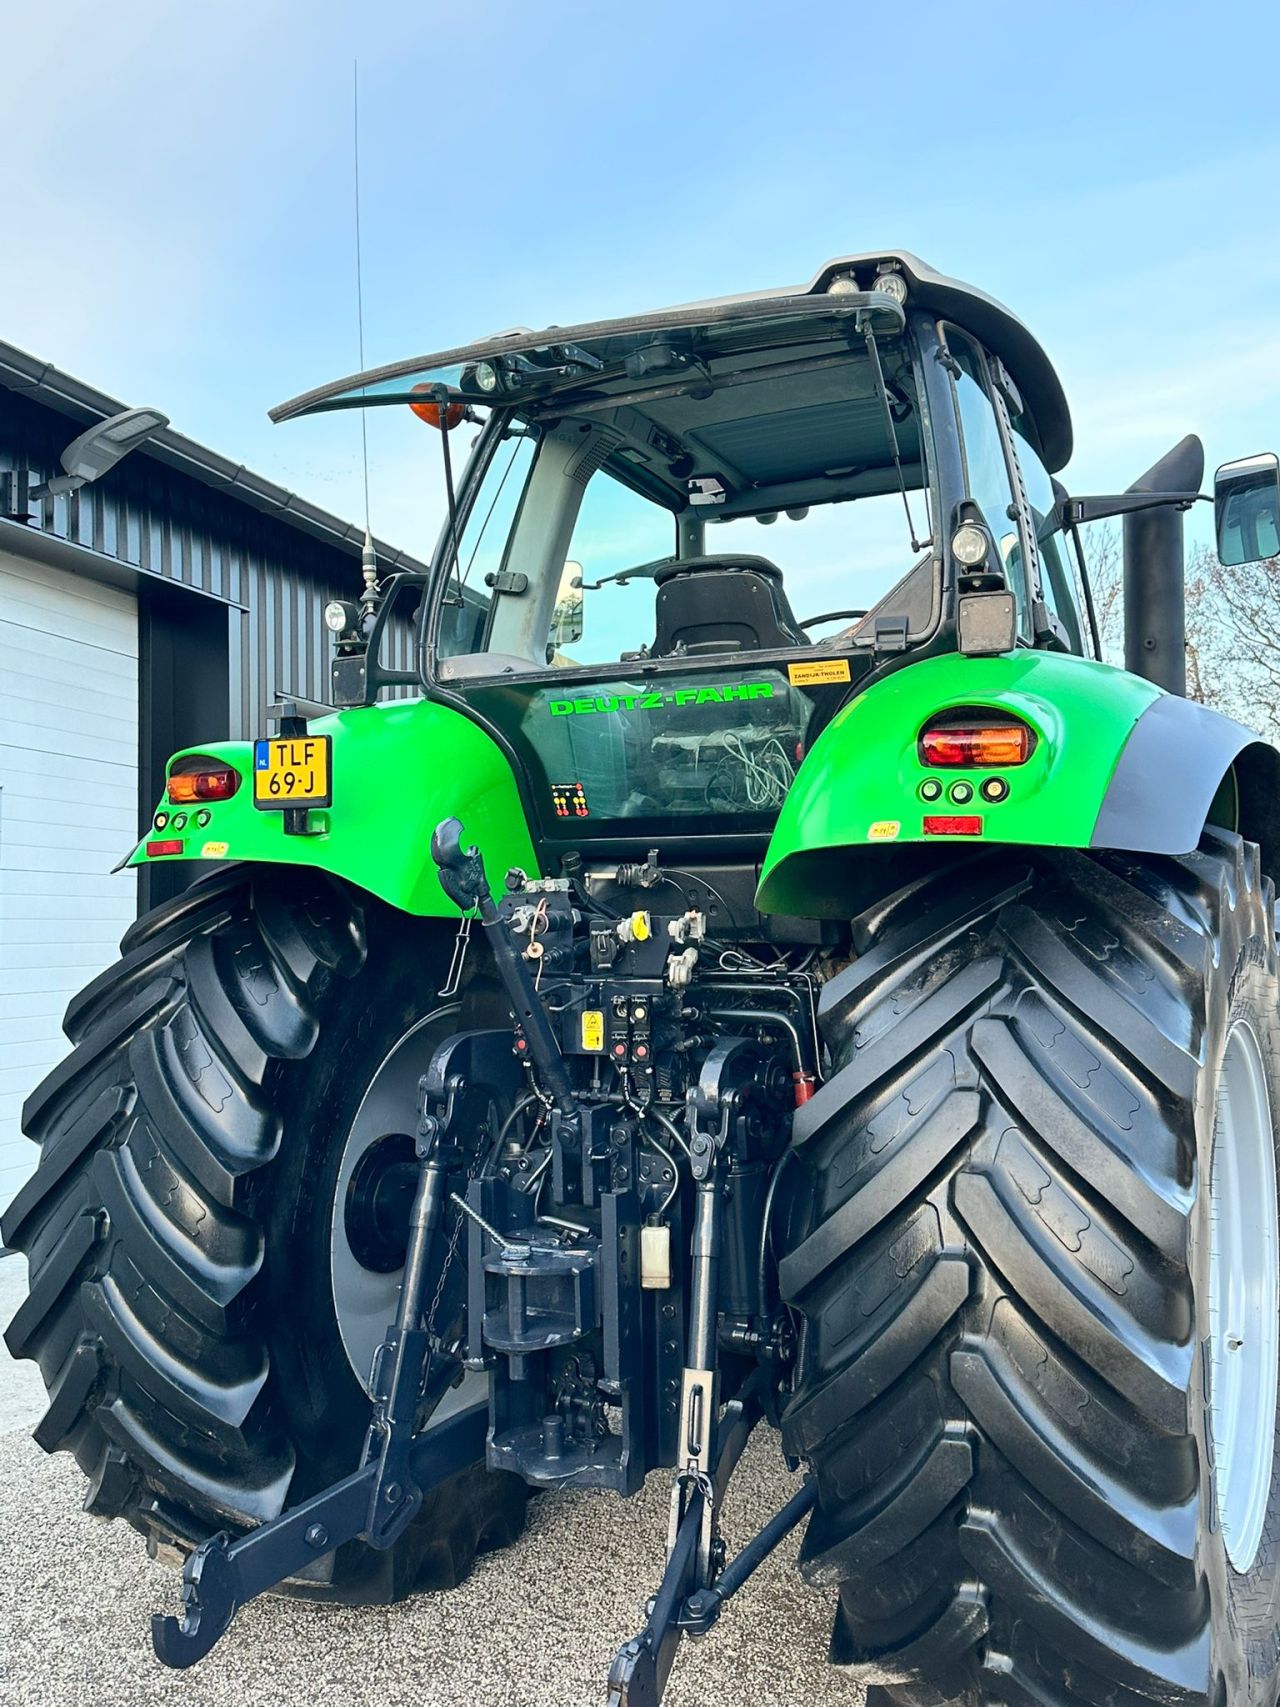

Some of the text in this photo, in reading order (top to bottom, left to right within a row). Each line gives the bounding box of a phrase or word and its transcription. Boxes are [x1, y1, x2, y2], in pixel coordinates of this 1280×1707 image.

[550, 683, 774, 716] DEUTZ-FAHR
[276, 743, 315, 767] TLF
[269, 771, 314, 795] 69-J
